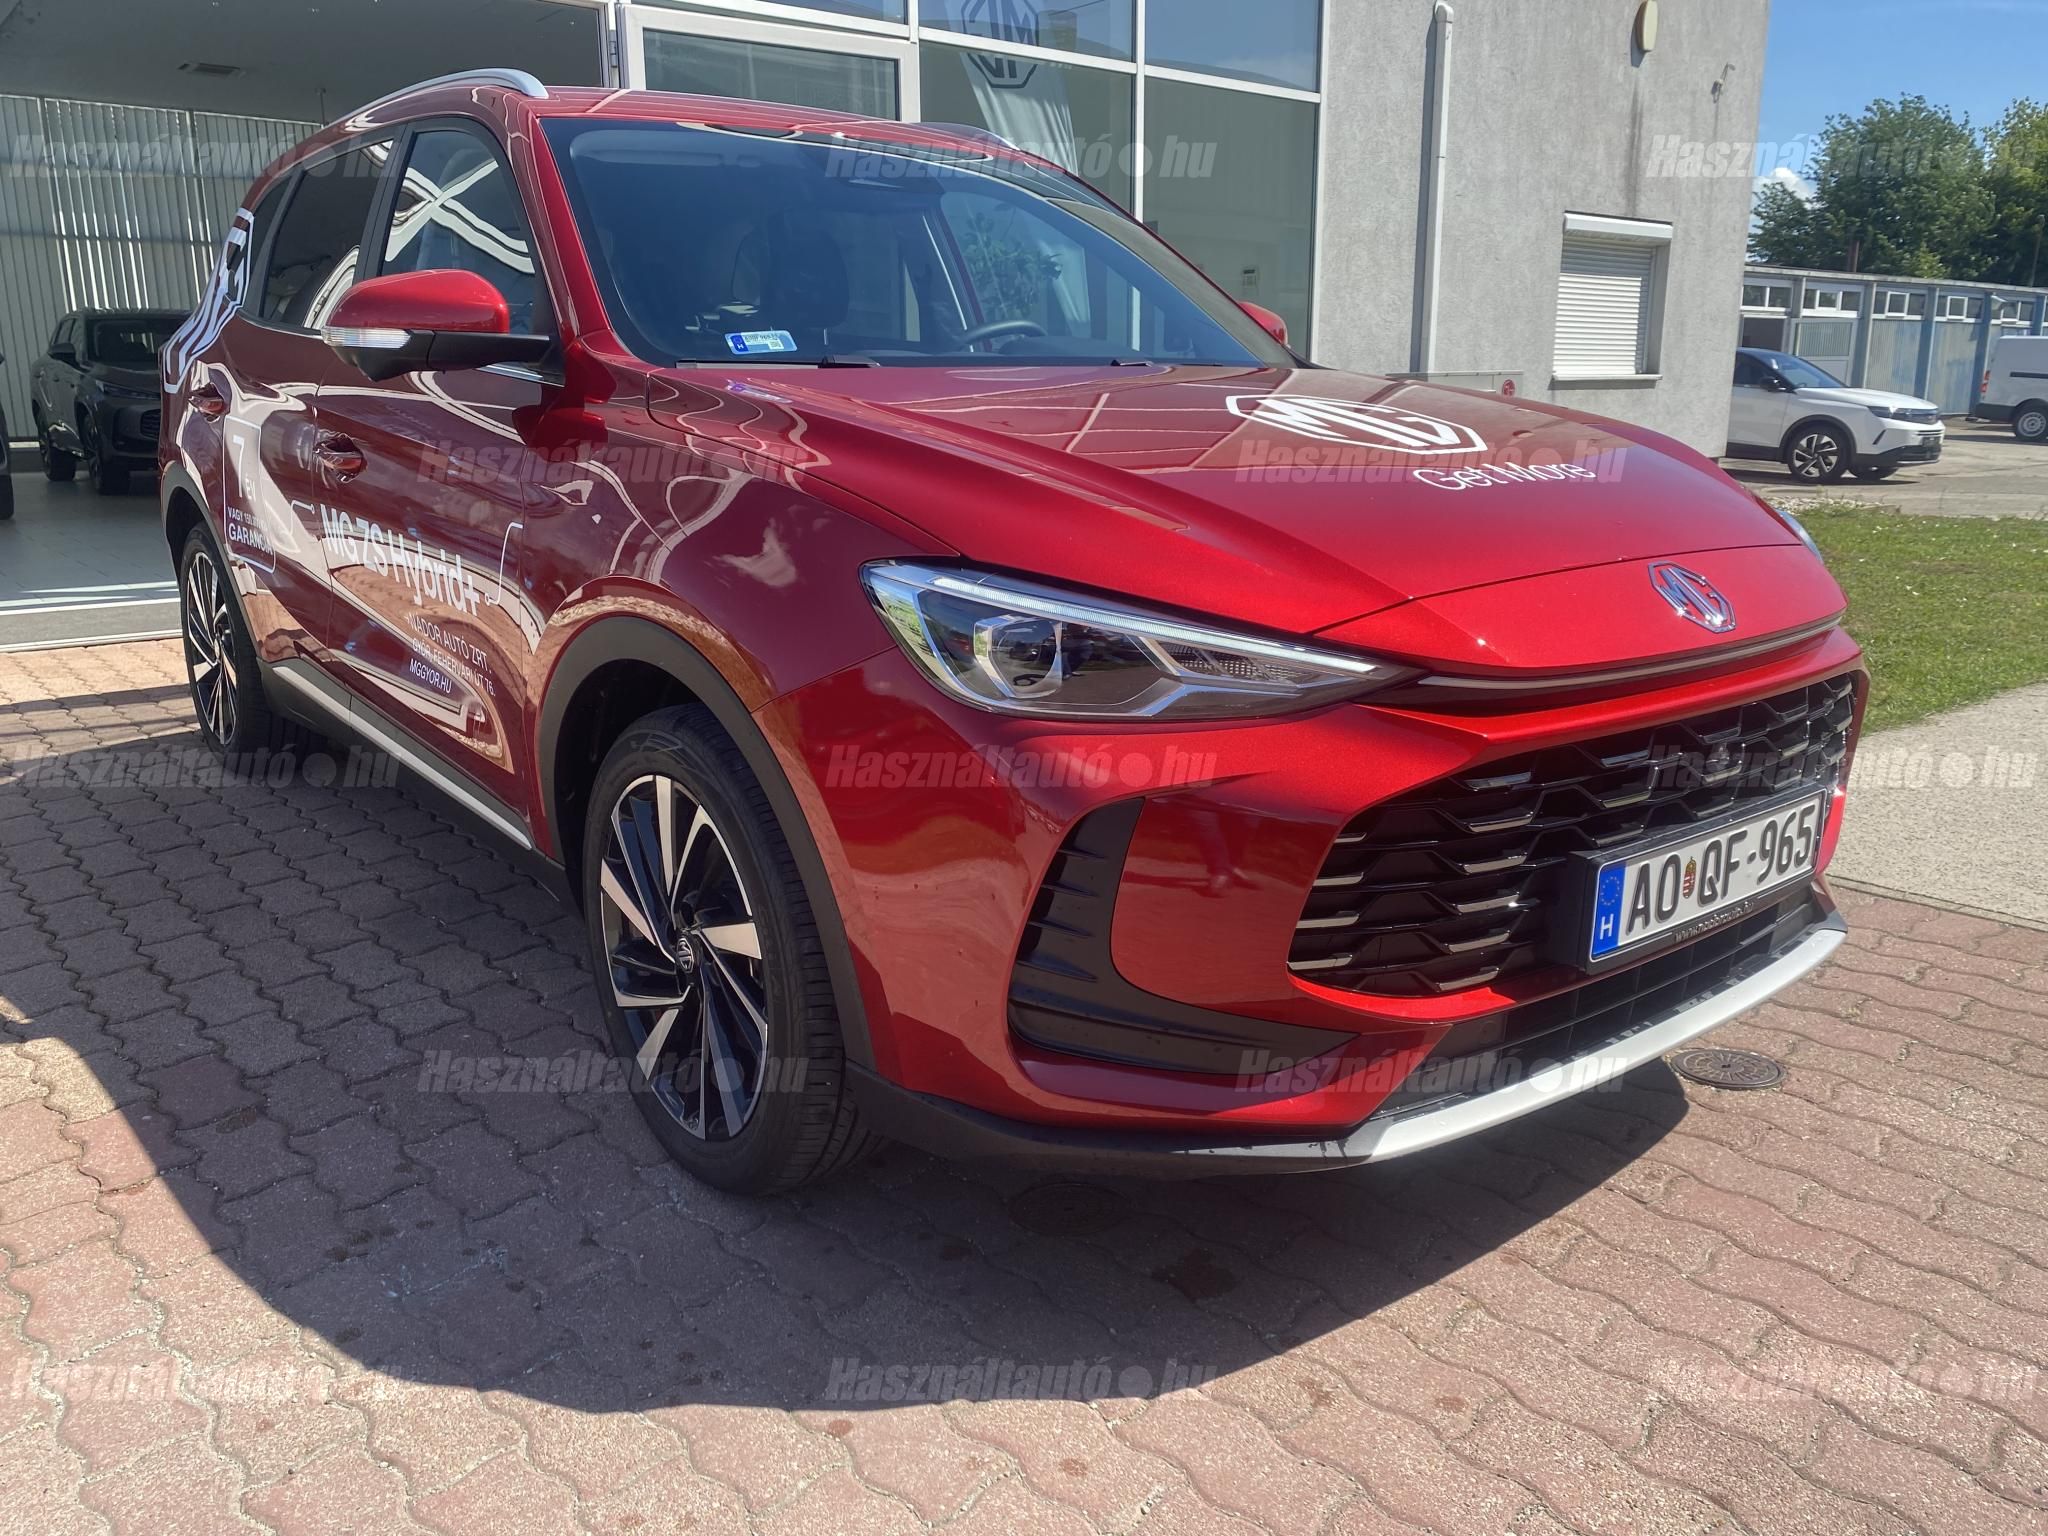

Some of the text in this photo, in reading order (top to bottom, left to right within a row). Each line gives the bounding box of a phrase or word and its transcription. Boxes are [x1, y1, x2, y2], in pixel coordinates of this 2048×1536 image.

[232, 434, 245, 498] 7
[1413, 461, 1597, 491] Get More
[320, 503, 481, 617] MG ZS Hybrid+
[1659, 566, 1729, 626] MG
[409, 658, 452, 694] MGGYOR.HU
[1625, 852, 1682, 936] AO
[1600, 913, 1614, 940] H
